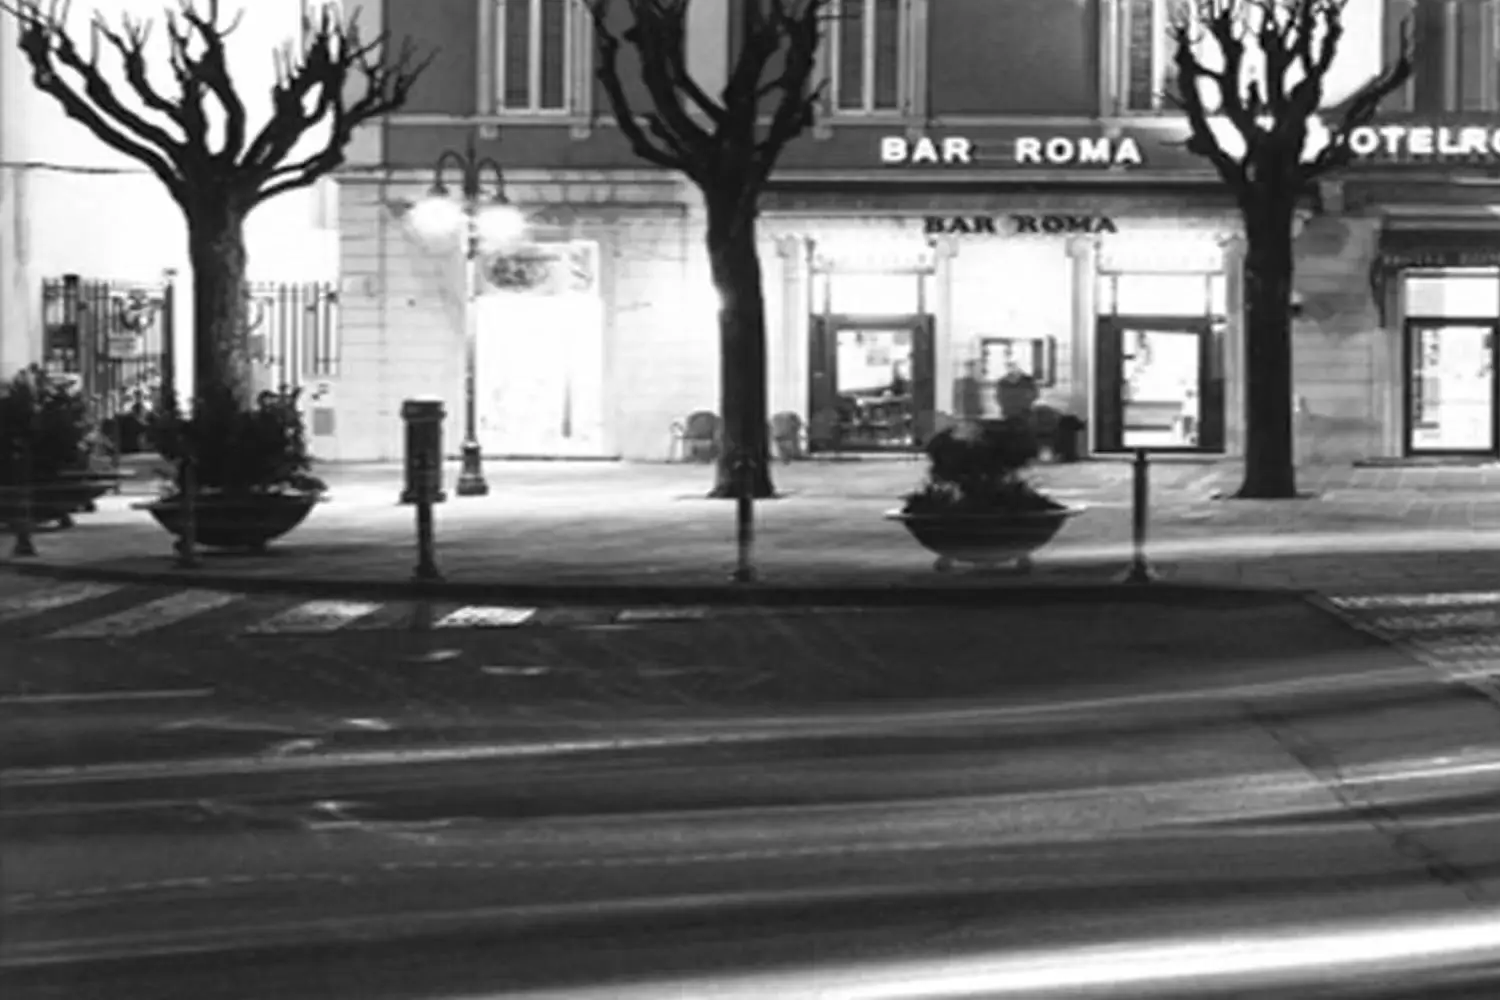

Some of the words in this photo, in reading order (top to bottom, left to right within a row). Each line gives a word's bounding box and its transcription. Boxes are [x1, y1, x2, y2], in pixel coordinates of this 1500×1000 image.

[881, 136, 971, 163] BAR
[1014, 136, 1142, 163] ROMA
[924, 214, 996, 233] BAR
[1008, 213, 1118, 233] ROMA
